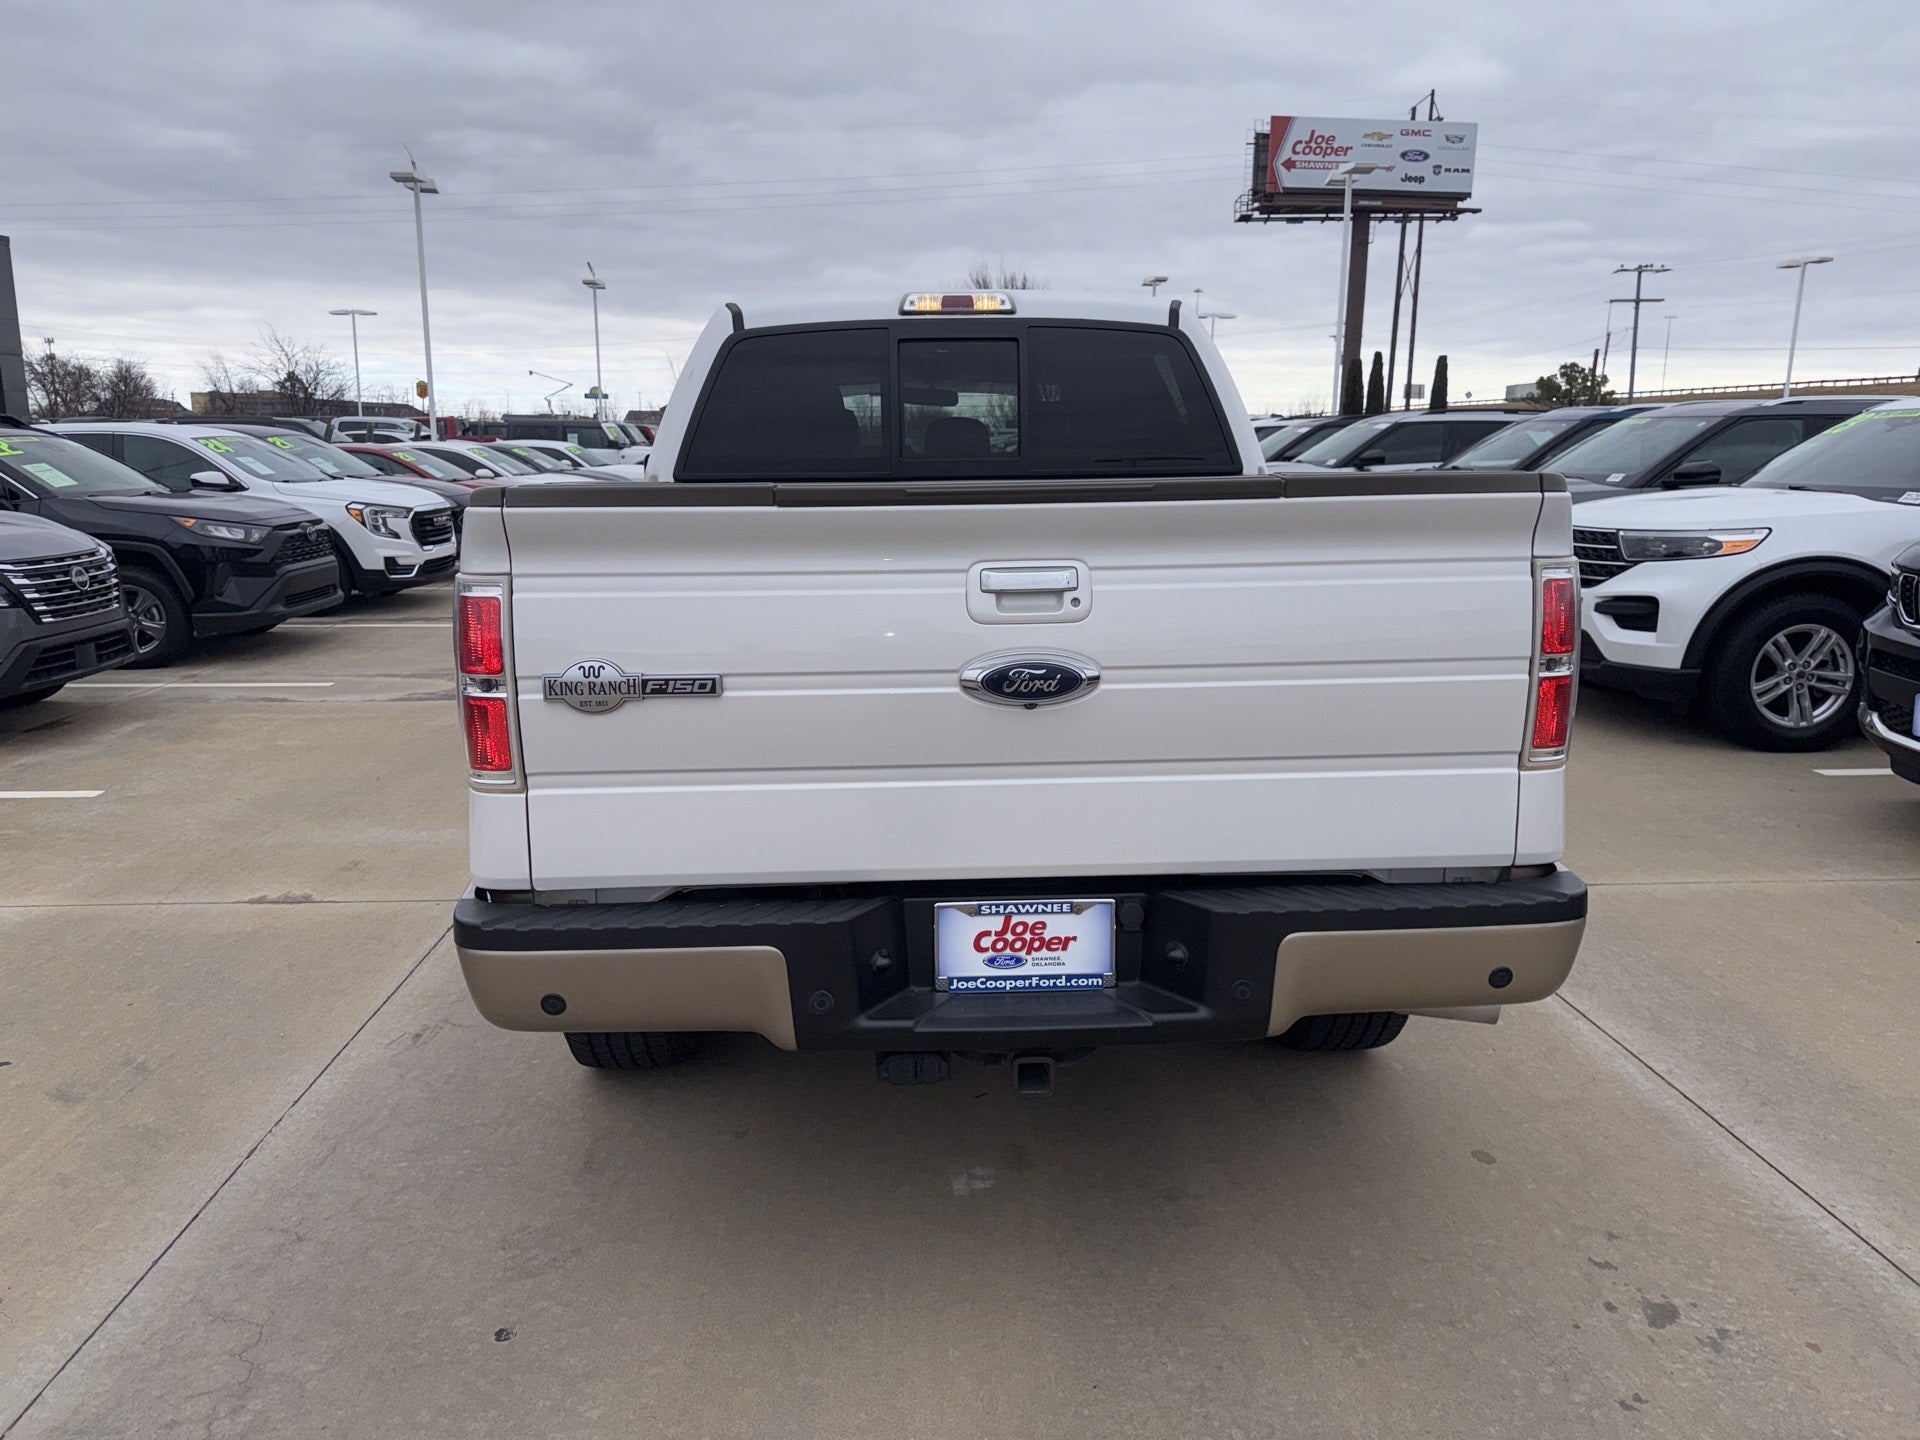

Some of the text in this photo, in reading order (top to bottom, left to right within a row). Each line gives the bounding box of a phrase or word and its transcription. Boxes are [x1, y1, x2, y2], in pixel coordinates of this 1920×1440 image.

[1304, 129, 1336, 145] Joe
[1400, 129, 1432, 137] GMC
[1291, 140, 1353, 158] Cooper
[1404, 150, 1426, 161] Ford
[1296, 161, 1339, 170] SHAWNE
[1400, 173, 1426, 184] Jeep
[547, 678, 638, 697] KING RANCH
[645, 680, 713, 694] F-150
[1001, 668, 1062, 693] Ford
[980, 903, 1072, 915] SHAWNEE
[993, 914, 1048, 938] Joe
[972, 930, 1078, 956] Cooper
[950, 975, 1103, 990] JoeCooperFord.com
